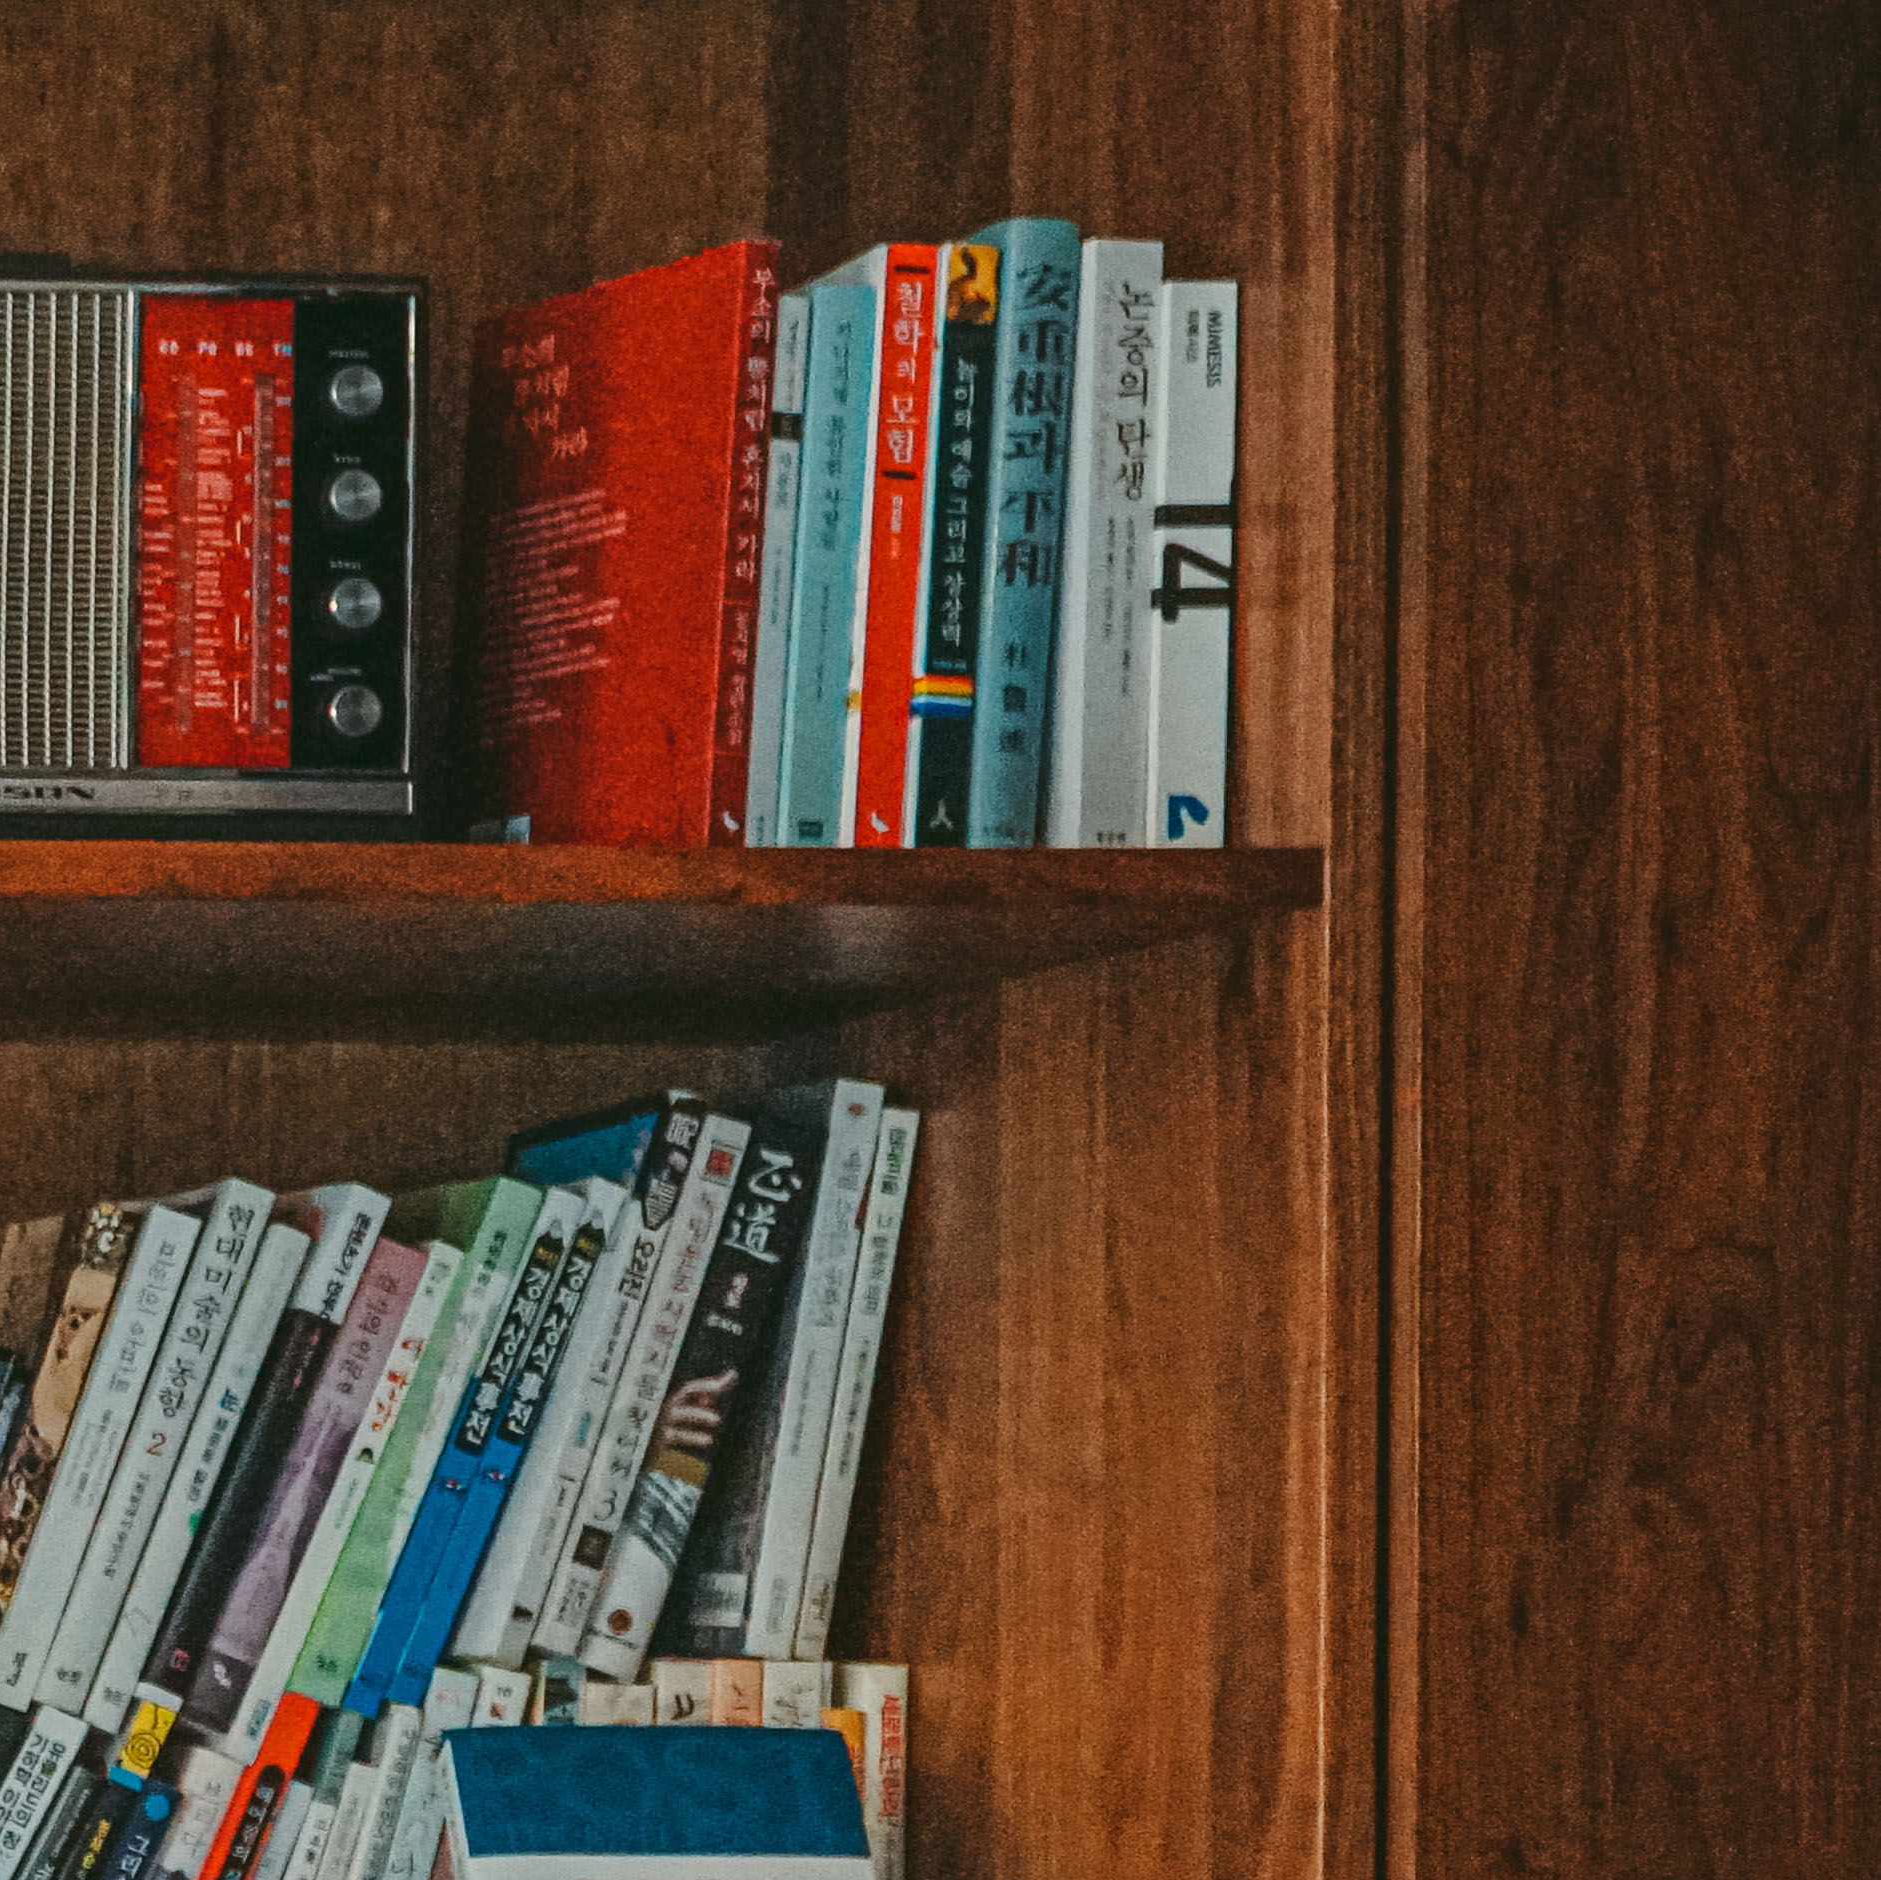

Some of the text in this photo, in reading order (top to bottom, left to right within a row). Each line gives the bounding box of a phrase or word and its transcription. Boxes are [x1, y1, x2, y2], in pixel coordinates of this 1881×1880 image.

[1205, 310, 1225, 388] MIMESIS
[884, 394, 919, 463] 모험
[942, 496, 970, 564] 그리고
[617, 1236, 657, 1300] 오리진
[144, 1430, 168, 1457] 2
[11, 1731, 51, 1787] 기하학
